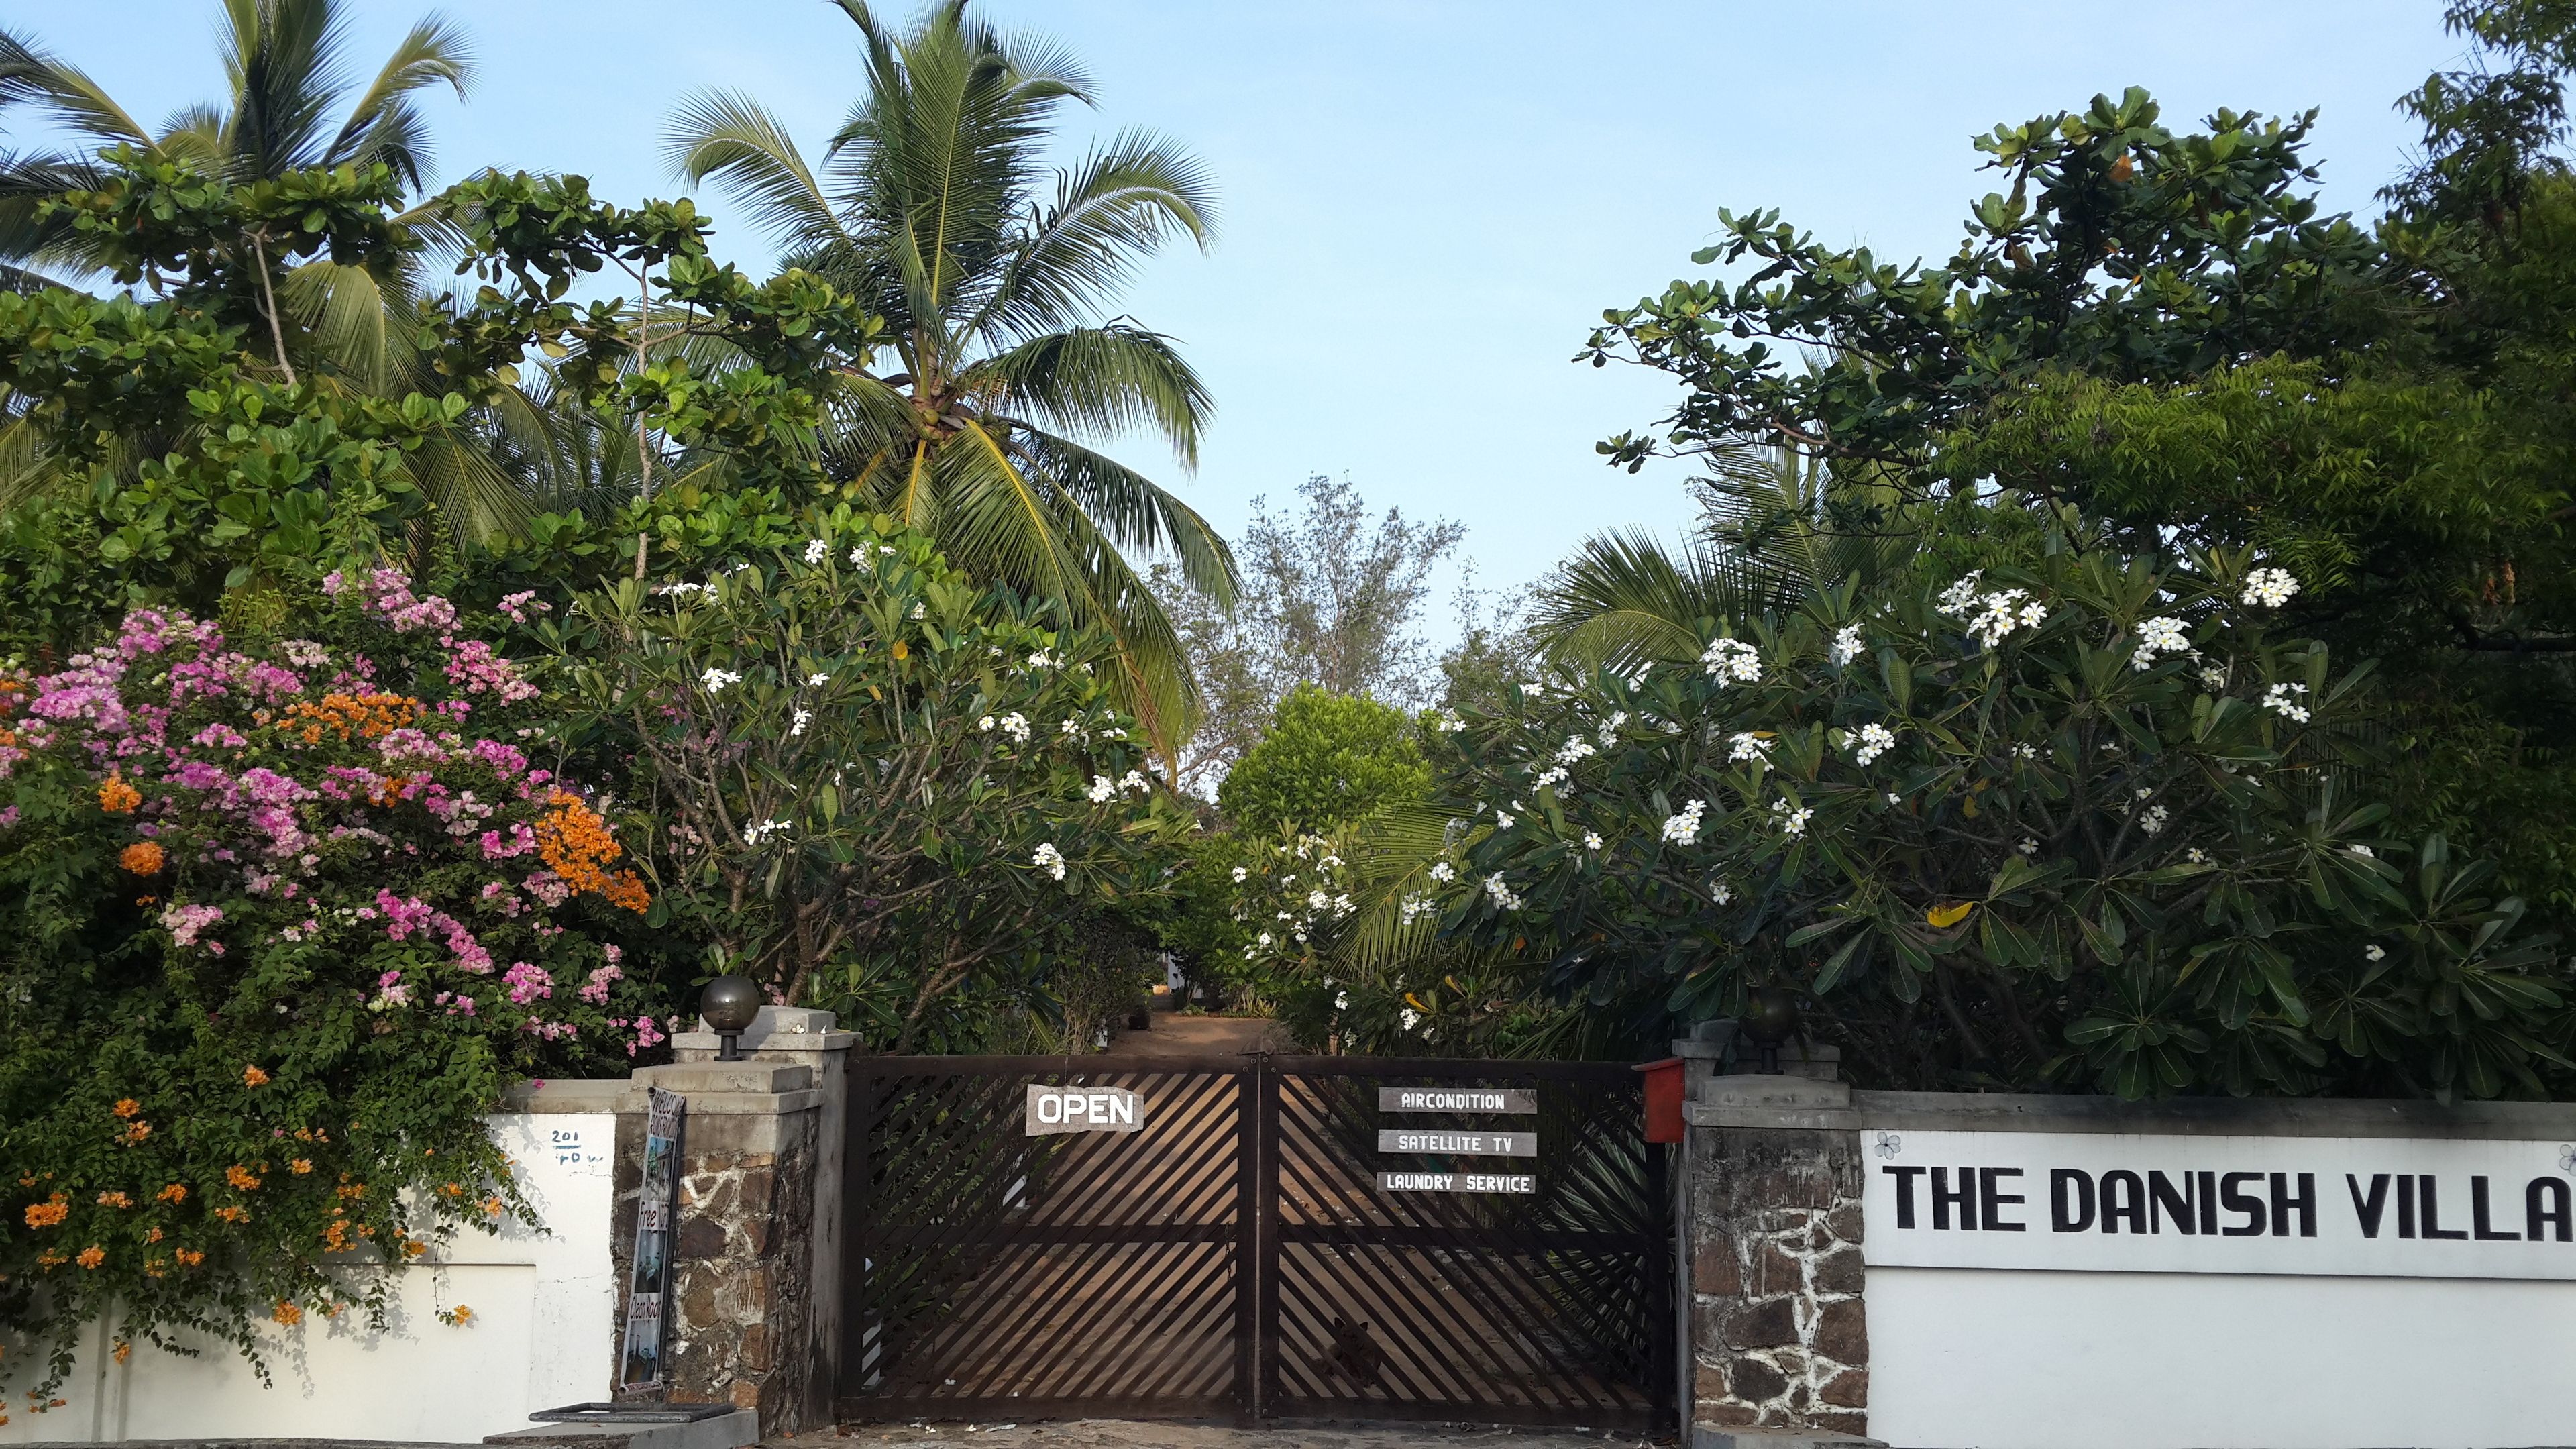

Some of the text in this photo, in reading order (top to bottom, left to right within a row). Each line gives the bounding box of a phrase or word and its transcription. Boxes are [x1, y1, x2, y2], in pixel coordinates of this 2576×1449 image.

[1037, 1093, 1134, 1124] OPEN
[1401, 1093, 1505, 1110] AIRCONDITION
[551, 1130, 578, 1143] 201
[1399, 1135, 1512, 1152] SATELLITE TV
[1387, 1174, 1530, 1192] LAUNDRY SERVICE
[1882, 1165, 2574, 1242] THE DANISH VILLA
